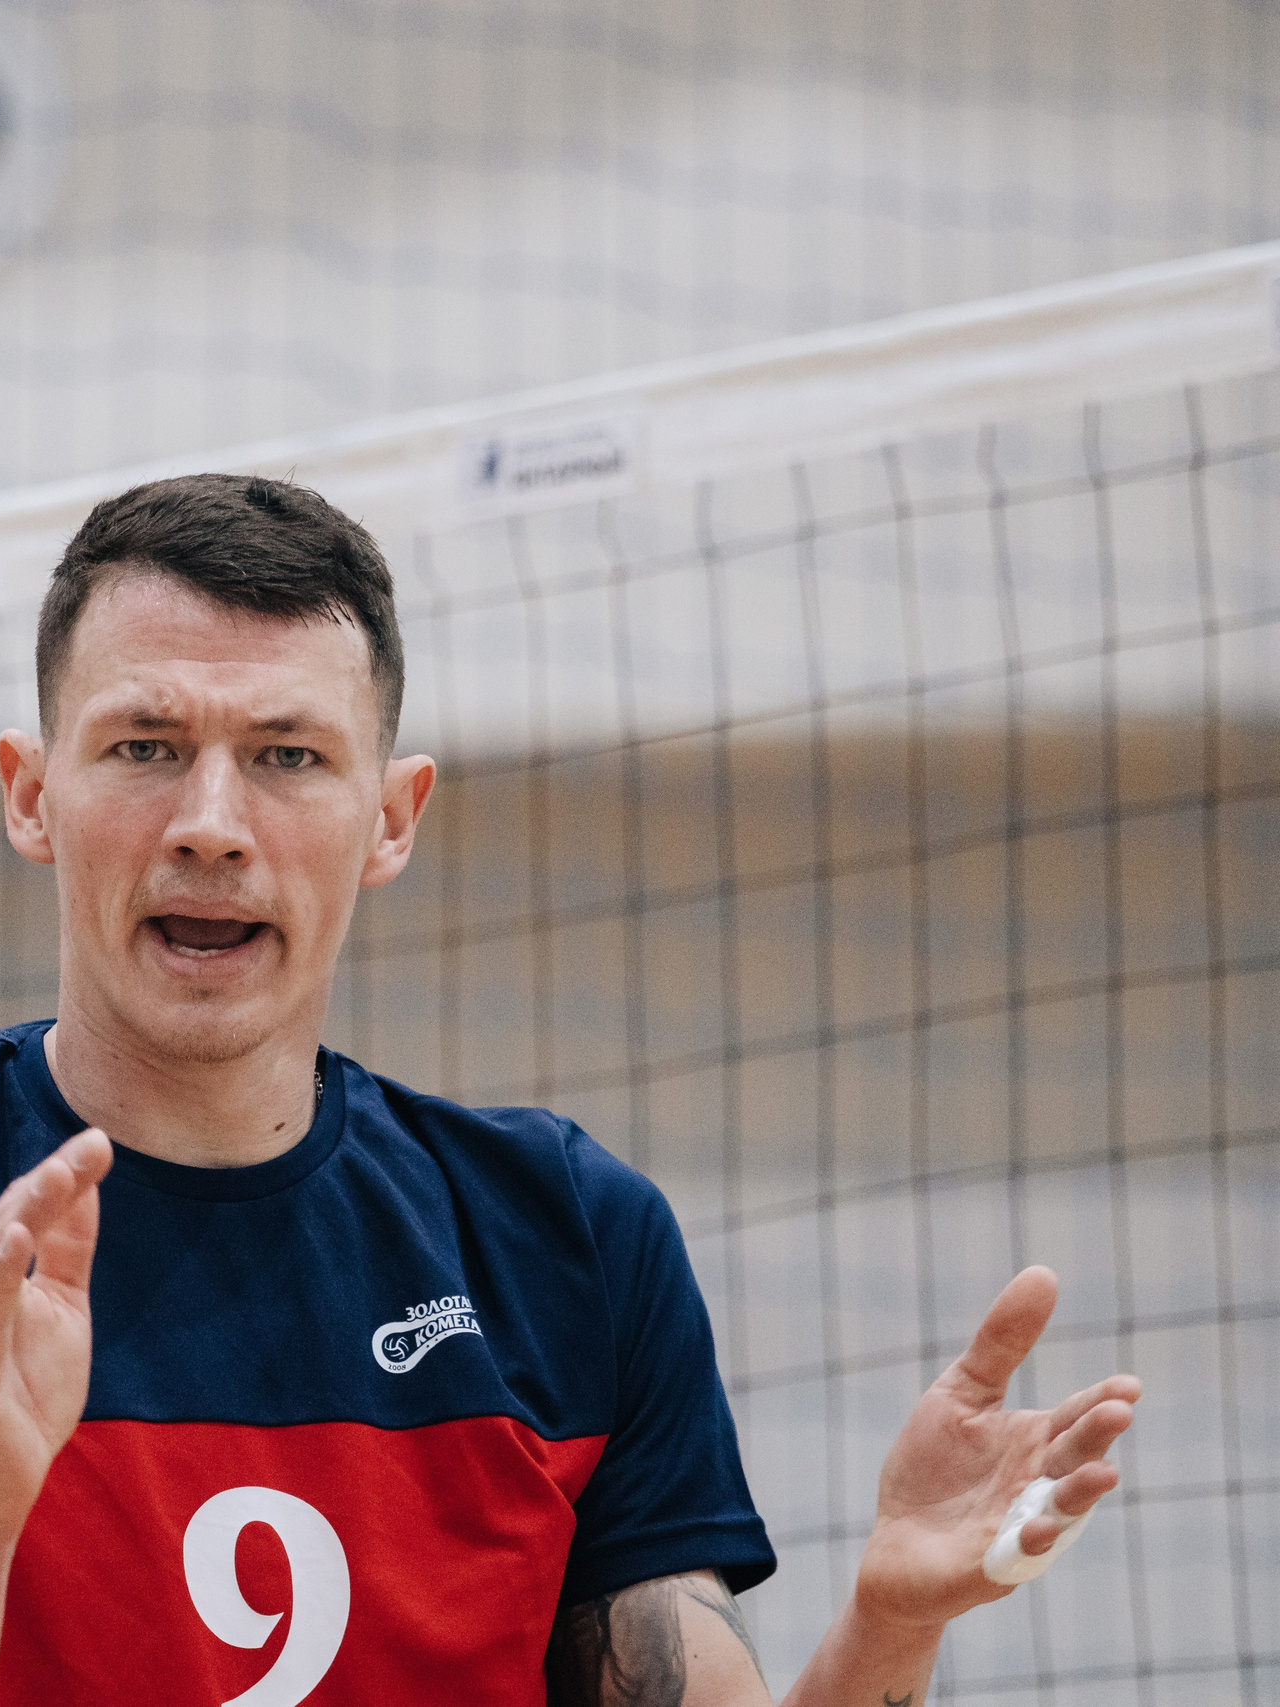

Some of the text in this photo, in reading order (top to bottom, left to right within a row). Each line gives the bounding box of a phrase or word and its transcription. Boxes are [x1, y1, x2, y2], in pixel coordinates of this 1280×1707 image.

[405, 1295, 473, 1321] ЗОЛОТА
[414, 1314, 482, 1348] КОМЕТА
[183, 1486, 351, 1707] 9
